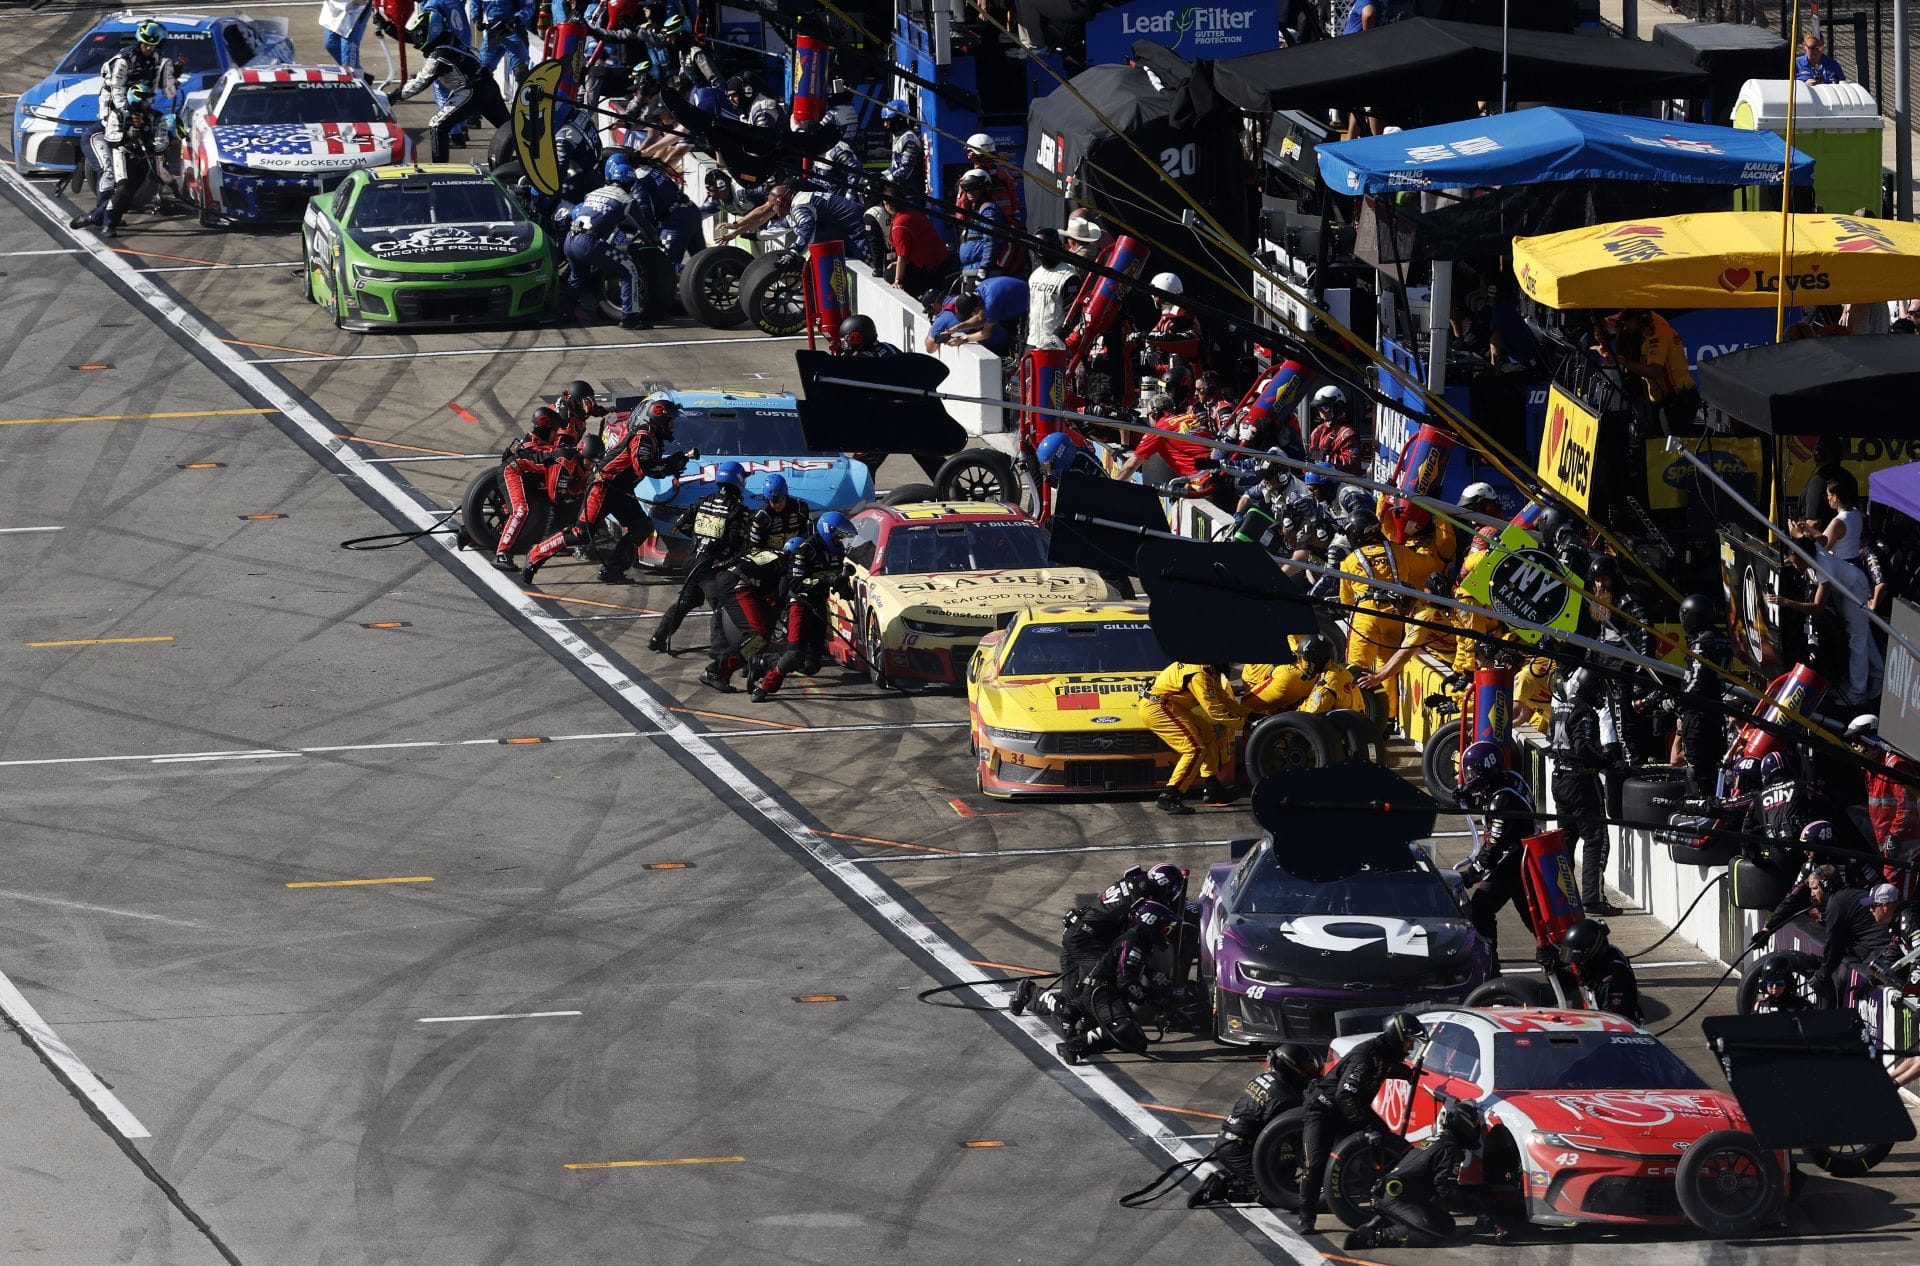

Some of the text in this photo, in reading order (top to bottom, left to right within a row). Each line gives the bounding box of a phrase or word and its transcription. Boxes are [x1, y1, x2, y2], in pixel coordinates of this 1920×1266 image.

[1122, 8, 1254, 34] Leaf Filter
[167, 33, 205, 41] AMLIN
[1195, 30, 1225, 38] GUTTER
[1195, 36, 1242, 45] PROTECTION
[259, 157, 367, 167] SHOP JOCKEY.COM
[1743, 162, 1779, 172] KAULIG
[1388, 169, 1424, 178] KAULIG
[1740, 171, 1775, 180] RACING
[376, 245, 518, 259] NICOTINE POUCHES
[352, 279, 368, 290] 16
[833, 257, 846, 305] SUNOCO
[1030, 281, 1060, 296] FFICIAL
[1272, 374, 1300, 414] SUNOCO
[1528, 390, 1548, 404] 10
[1417, 448, 1440, 497] SUNOCO
[1508, 554, 1564, 604] NY
[943, 593, 1010, 606] SEAFOOD
[1015, 592, 1035, 600] TO
[1498, 583, 1538, 622] RACING
[1103, 623, 1152, 631] GILLILA
[1054, 682, 1144, 696] Fleetguar
[1494, 689, 1506, 743] SUNOCO
[1010, 753, 1025, 765] 34
[1483, 752, 1497, 769] 48
[1739, 759, 1755, 770] 48
[1762, 787, 1795, 809] ally
[1819, 827, 1833, 840] 48
[1152, 871, 1169, 887] 48
[1557, 855, 1578, 908] SUNOCO
[1140, 911, 1157, 925] 48
[1245, 985, 1266, 999] 48
[1610, 1036, 1656, 1045] JONES
[1555, 1152, 1579, 1166] 43
[1331, 1163, 1342, 1199] EAGLE
